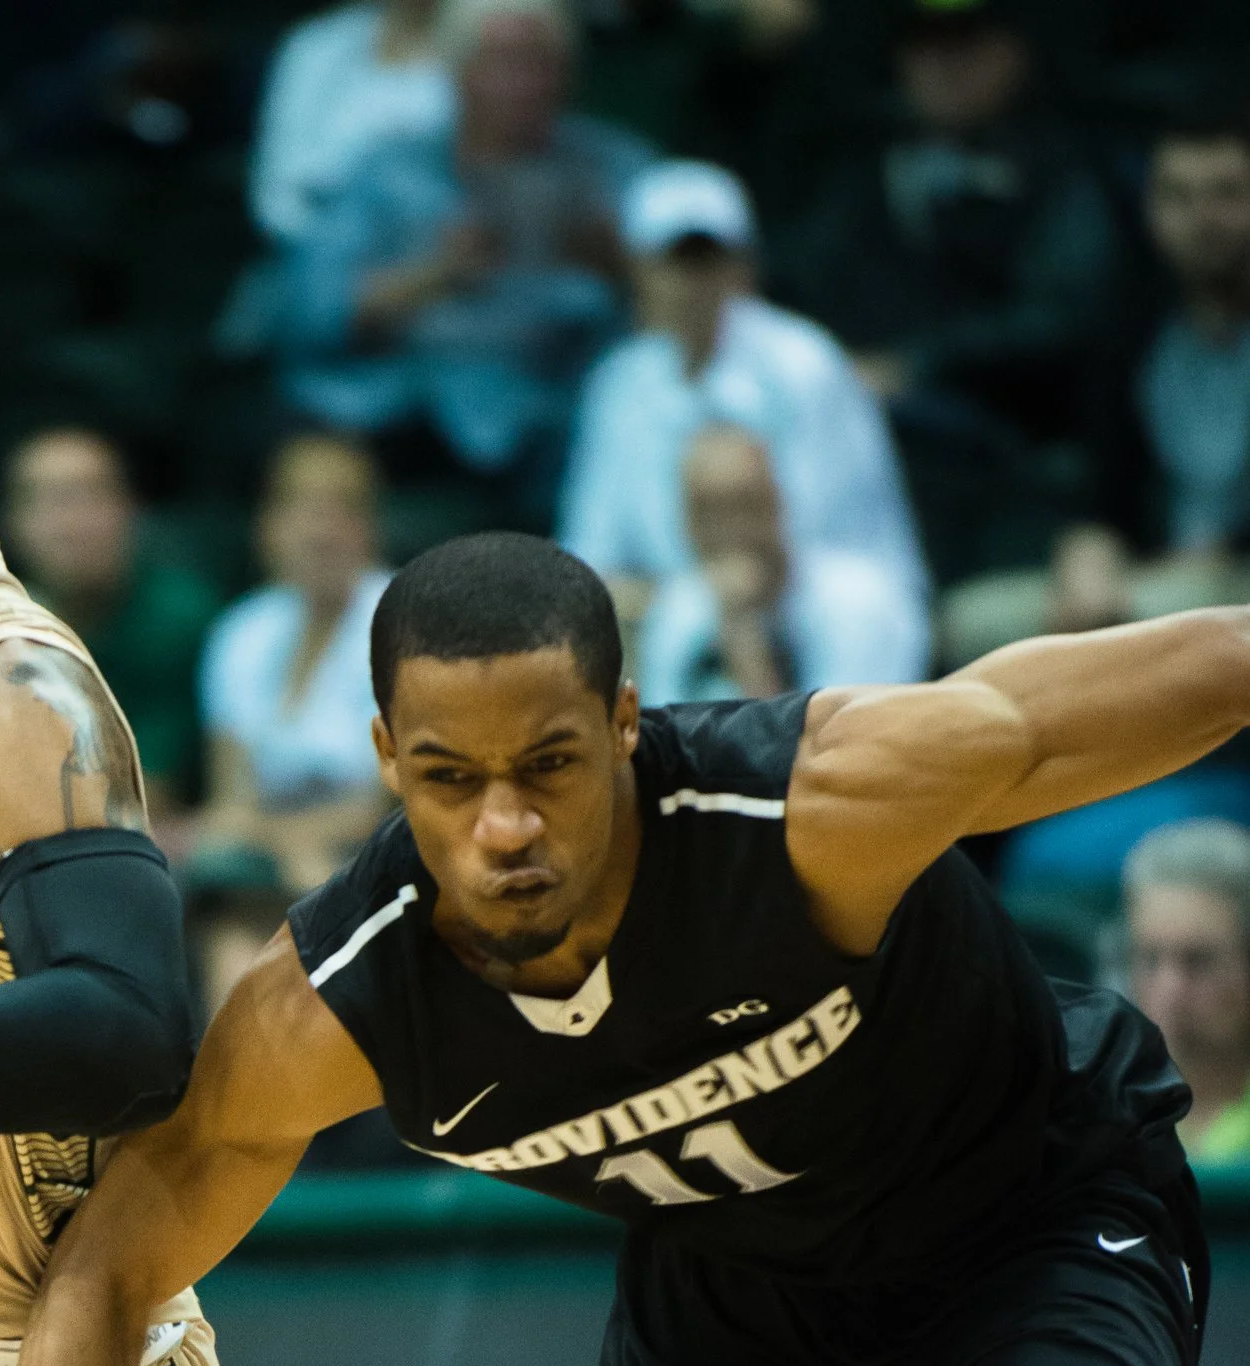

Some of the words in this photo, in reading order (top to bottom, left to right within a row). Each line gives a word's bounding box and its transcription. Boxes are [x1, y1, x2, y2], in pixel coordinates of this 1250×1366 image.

[708, 998, 769, 1027] DG
[402, 984, 863, 1172] ROVIDENCE
[593, 1119, 808, 1206] 11
